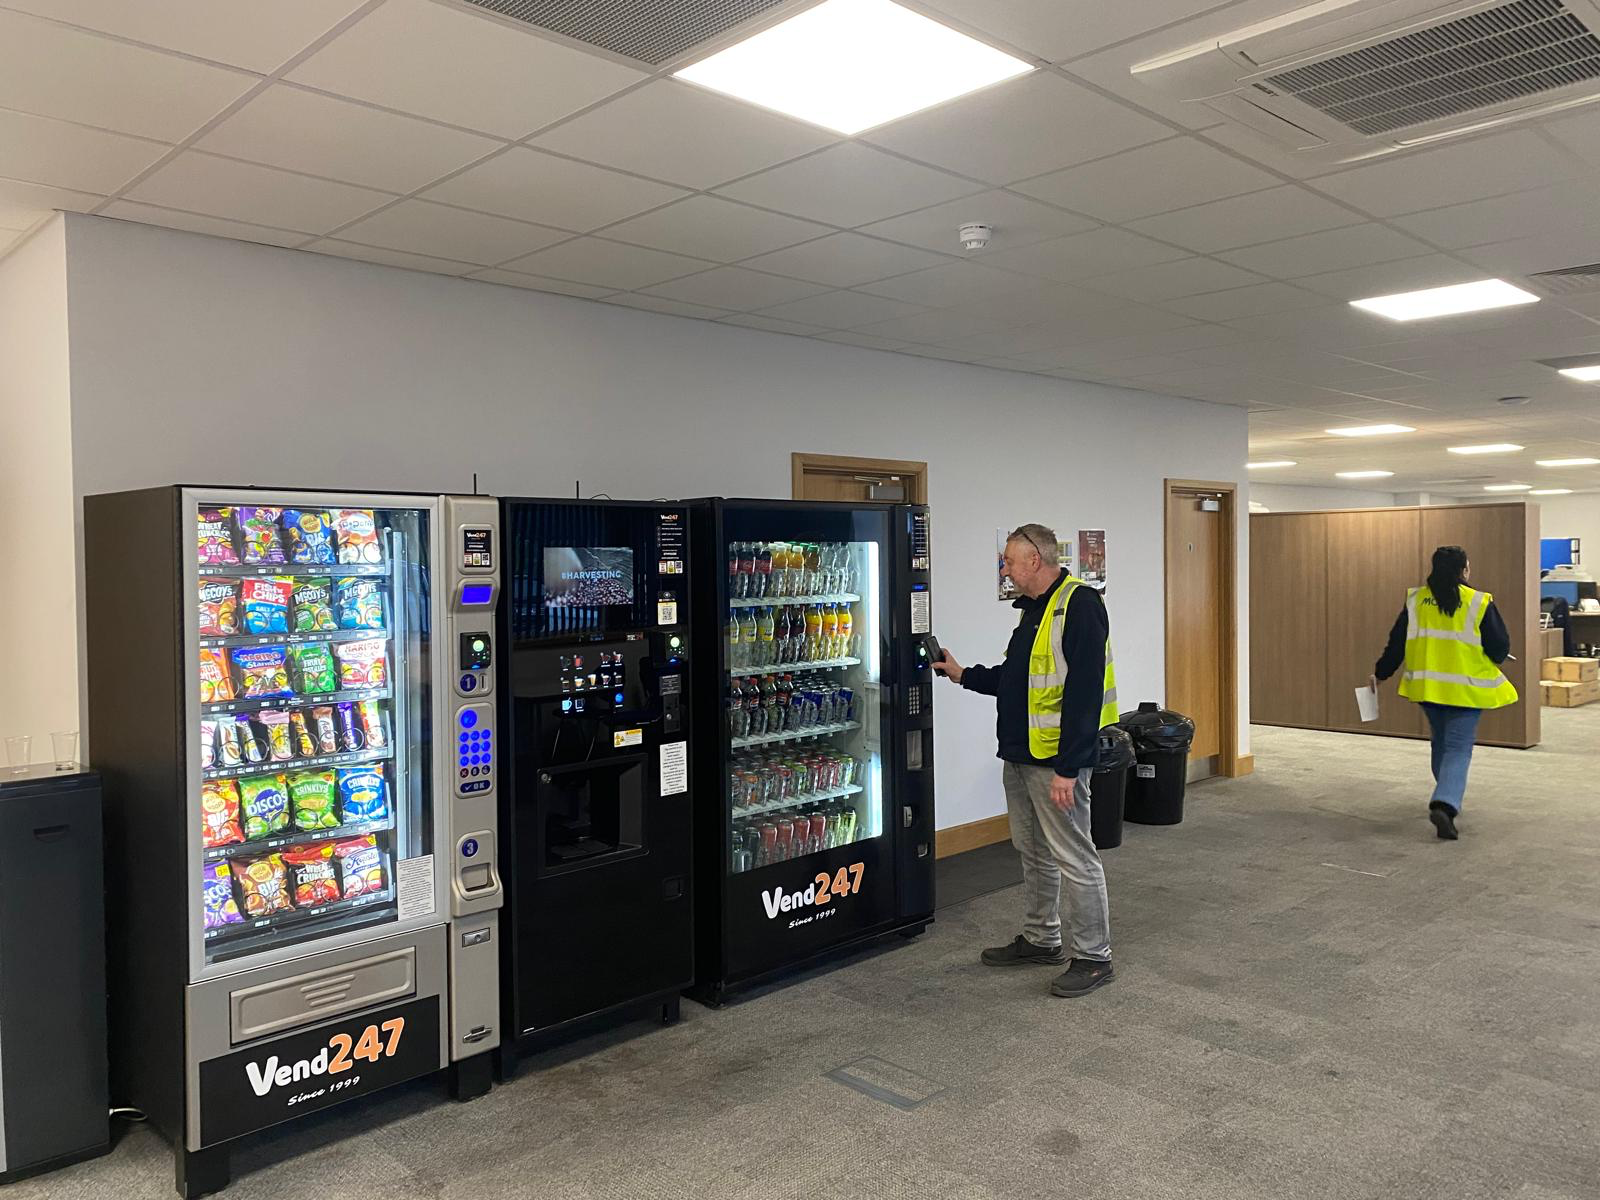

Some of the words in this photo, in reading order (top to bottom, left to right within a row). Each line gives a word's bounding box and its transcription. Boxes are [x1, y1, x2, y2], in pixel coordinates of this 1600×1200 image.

[252, 591, 285, 603] CHIPS
[465, 677, 471, 689] 1
[473, 782, 485, 790] OK
[246, 791, 288, 815] DISCOS
[466, 842, 473, 855] 3
[761, 862, 865, 919] Vend247
[788, 916, 814, 929] Since
[815, 908, 836, 921] 1999
[245, 1016, 405, 1097] Vend247
[287, 1088, 326, 1106] Since
[329, 1075, 361, 1093] 1999
